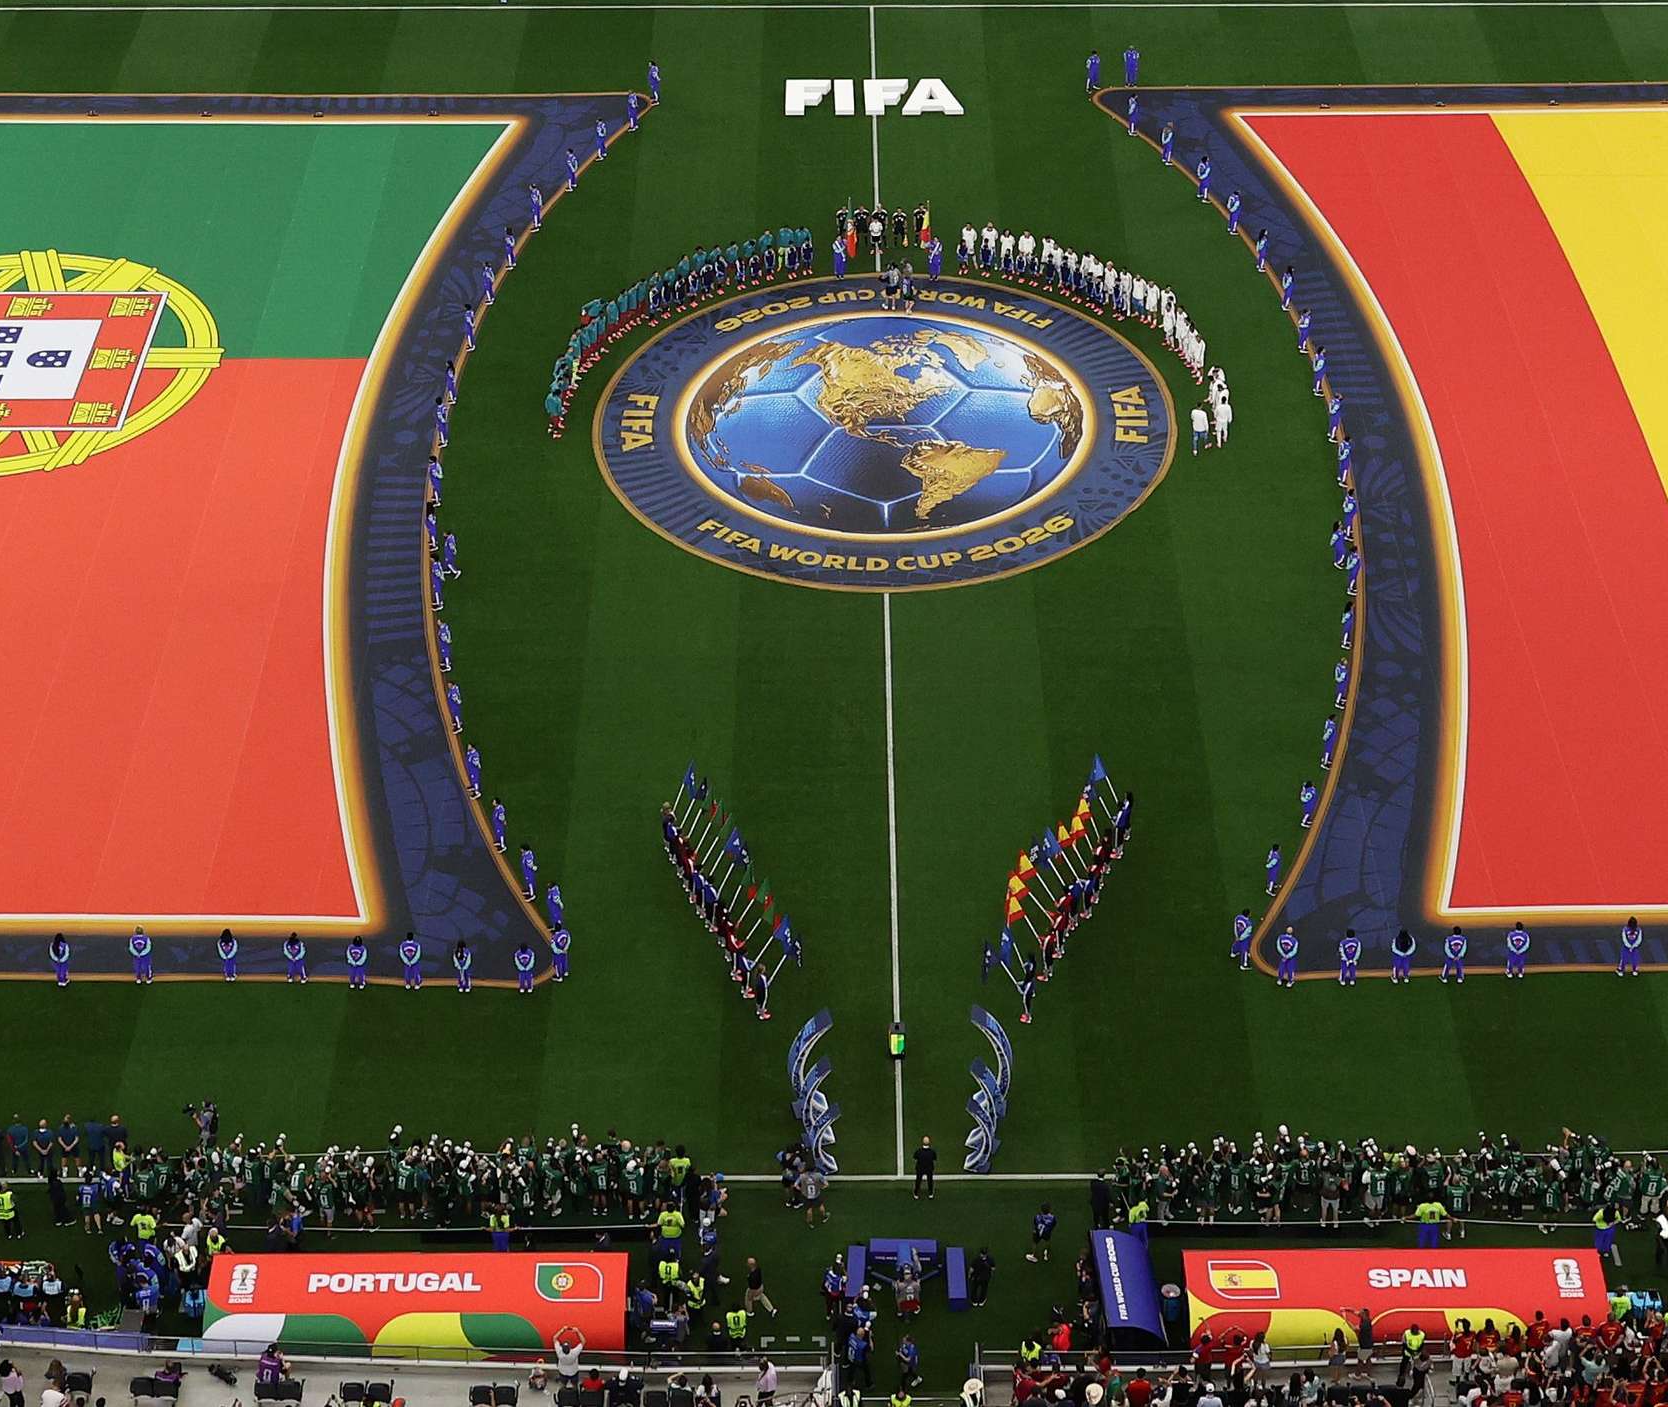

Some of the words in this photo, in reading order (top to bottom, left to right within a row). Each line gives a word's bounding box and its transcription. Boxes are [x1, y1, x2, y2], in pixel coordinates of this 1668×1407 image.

[784, 78, 965, 116] FIFA
[817, 289, 876, 304] CUP
[714, 295, 812, 332] 2026
[993, 301, 1054, 329] FIFA
[620, 394, 660, 452] FIFA
[1110, 385, 1149, 444] FIFA
[696, 518, 761, 554] FIFA
[768, 543, 889, 572] WORLD
[895, 551, 962, 572] CUP
[966, 514, 1075, 563] 2026
[307, 1273, 482, 1293] PORTUGAL
[1110, 1262, 1120, 1277] CUP
[1368, 1268, 1468, 1289] SPAIN
[1112, 1277, 1125, 1304] WORLD
[1118, 1303, 1129, 1320] FIFA
